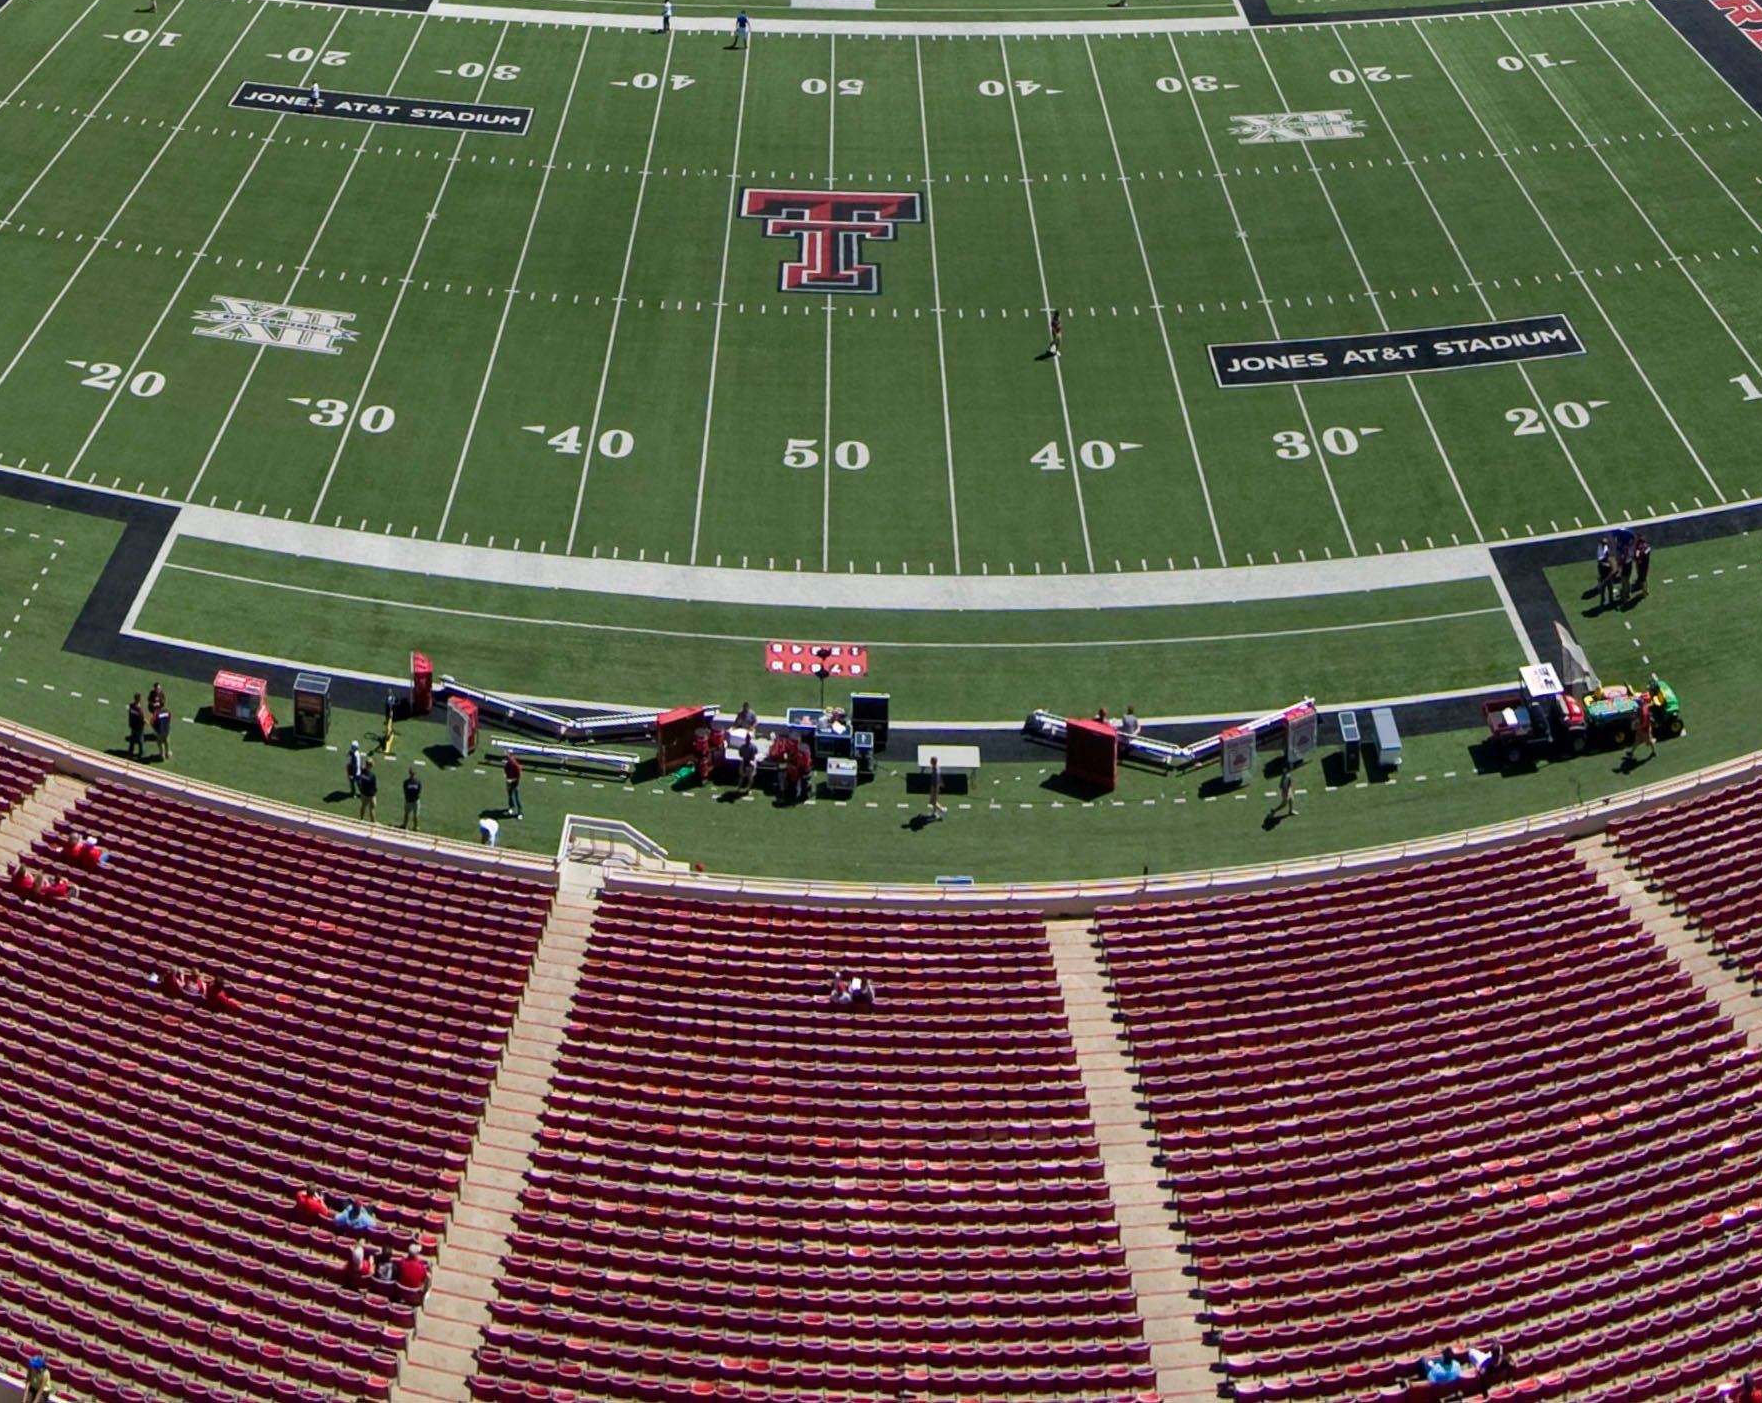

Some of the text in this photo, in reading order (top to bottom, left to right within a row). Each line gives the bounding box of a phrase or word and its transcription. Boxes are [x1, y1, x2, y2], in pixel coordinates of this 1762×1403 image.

[122, 28, 183, 48] 10
[285, 46, 353, 67] 20
[1495, 51, 1564, 73] 10
[456, 61, 523, 82] 30
[631, 72, 697, 92] 40
[1155, 74, 1220, 94] 30
[1328, 65, 1394, 86] 20
[800, 78, 866, 96] 50
[977, 78, 1043, 97] 40
[244, 91, 523, 127] JONES AT&T STADIUM
[1227, 327, 1568, 375] JONES AT&T STADIUM
[81, 361, 167, 398] 20
[308, 398, 397, 434] 30
[1504, 400, 1592, 438] 20
[546, 425, 635, 459] 40
[782, 437, 871, 471] 50
[1029, 439, 1117, 471] 40
[1272, 426, 1361, 462] 30
